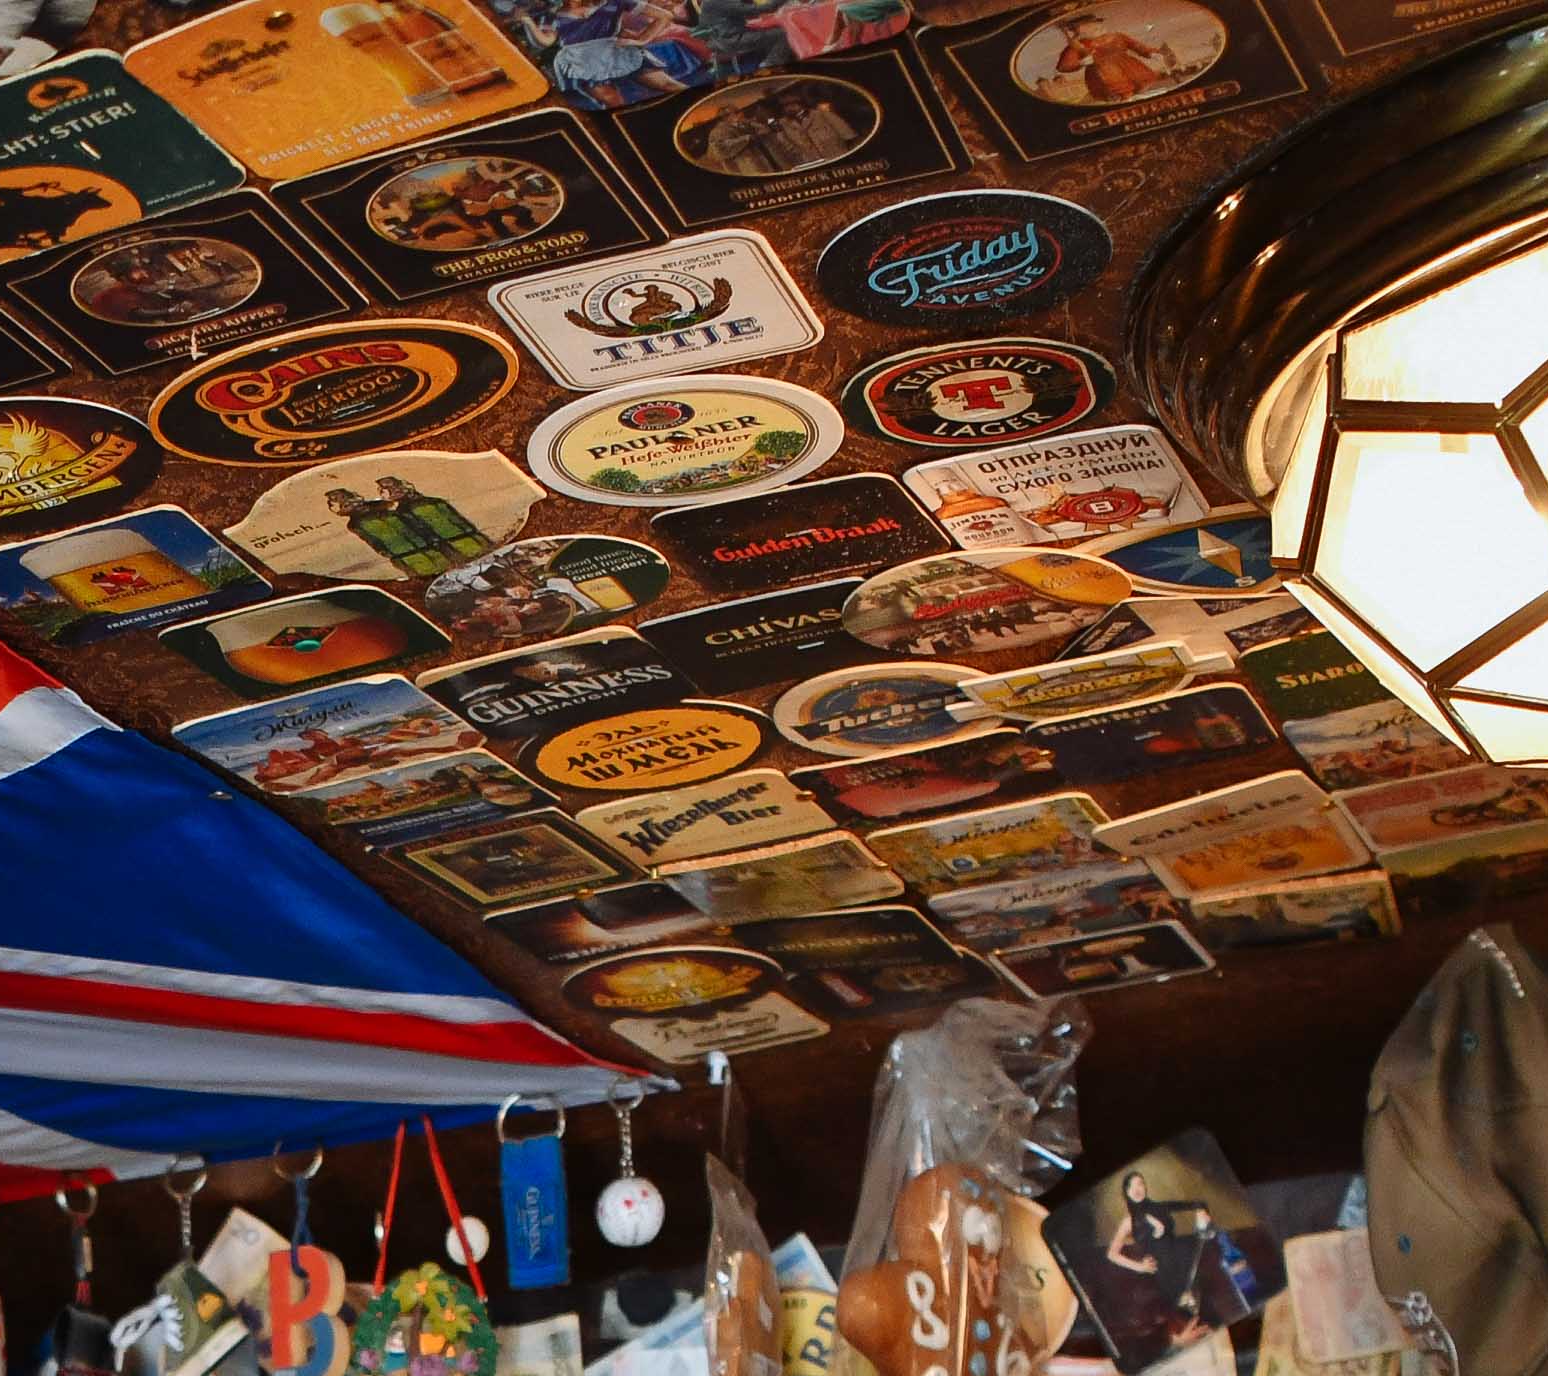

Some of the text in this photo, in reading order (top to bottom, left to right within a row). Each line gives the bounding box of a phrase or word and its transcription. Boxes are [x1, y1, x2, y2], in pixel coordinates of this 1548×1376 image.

[46, 101, 137, 151] STIER!
[1124, 107, 1200, 133] ENGLAND
[436, 260, 474, 276] THE
[867, 221, 1042, 308] Friday
[927, 263, 1046, 306] AVENUE
[593, 317, 765, 363] TITJE
[195, 342, 410, 414] CAINS
[893, 354, 1055, 395] TENNENT'S
[942, 375, 1016, 412] T
[272, 369, 408, 428] LIVERPOOL
[586, 414, 767, 461] PAULANER
[930, 409, 1055, 438] LAGER
[977, 432, 1152, 477] ОТПРАЗДНУЙ
[995, 458, 1166, 496] СУХОГО ЗАКОНА!
[559, 560, 593, 575] Good
[712, 534, 814, 565] Gulden
[566, 566, 597, 581] Good
[572, 570, 603, 584] Great
[704, 608, 843, 647] CHIVAS
[465, 663, 674, 727] GUINNESS
[534, 686, 629, 718] DRAUGHT
[618, 780, 773, 857] Wieselburger
[723, 803, 784, 827] Bier
[525, 1185, 543, 1261] GUINNESS
